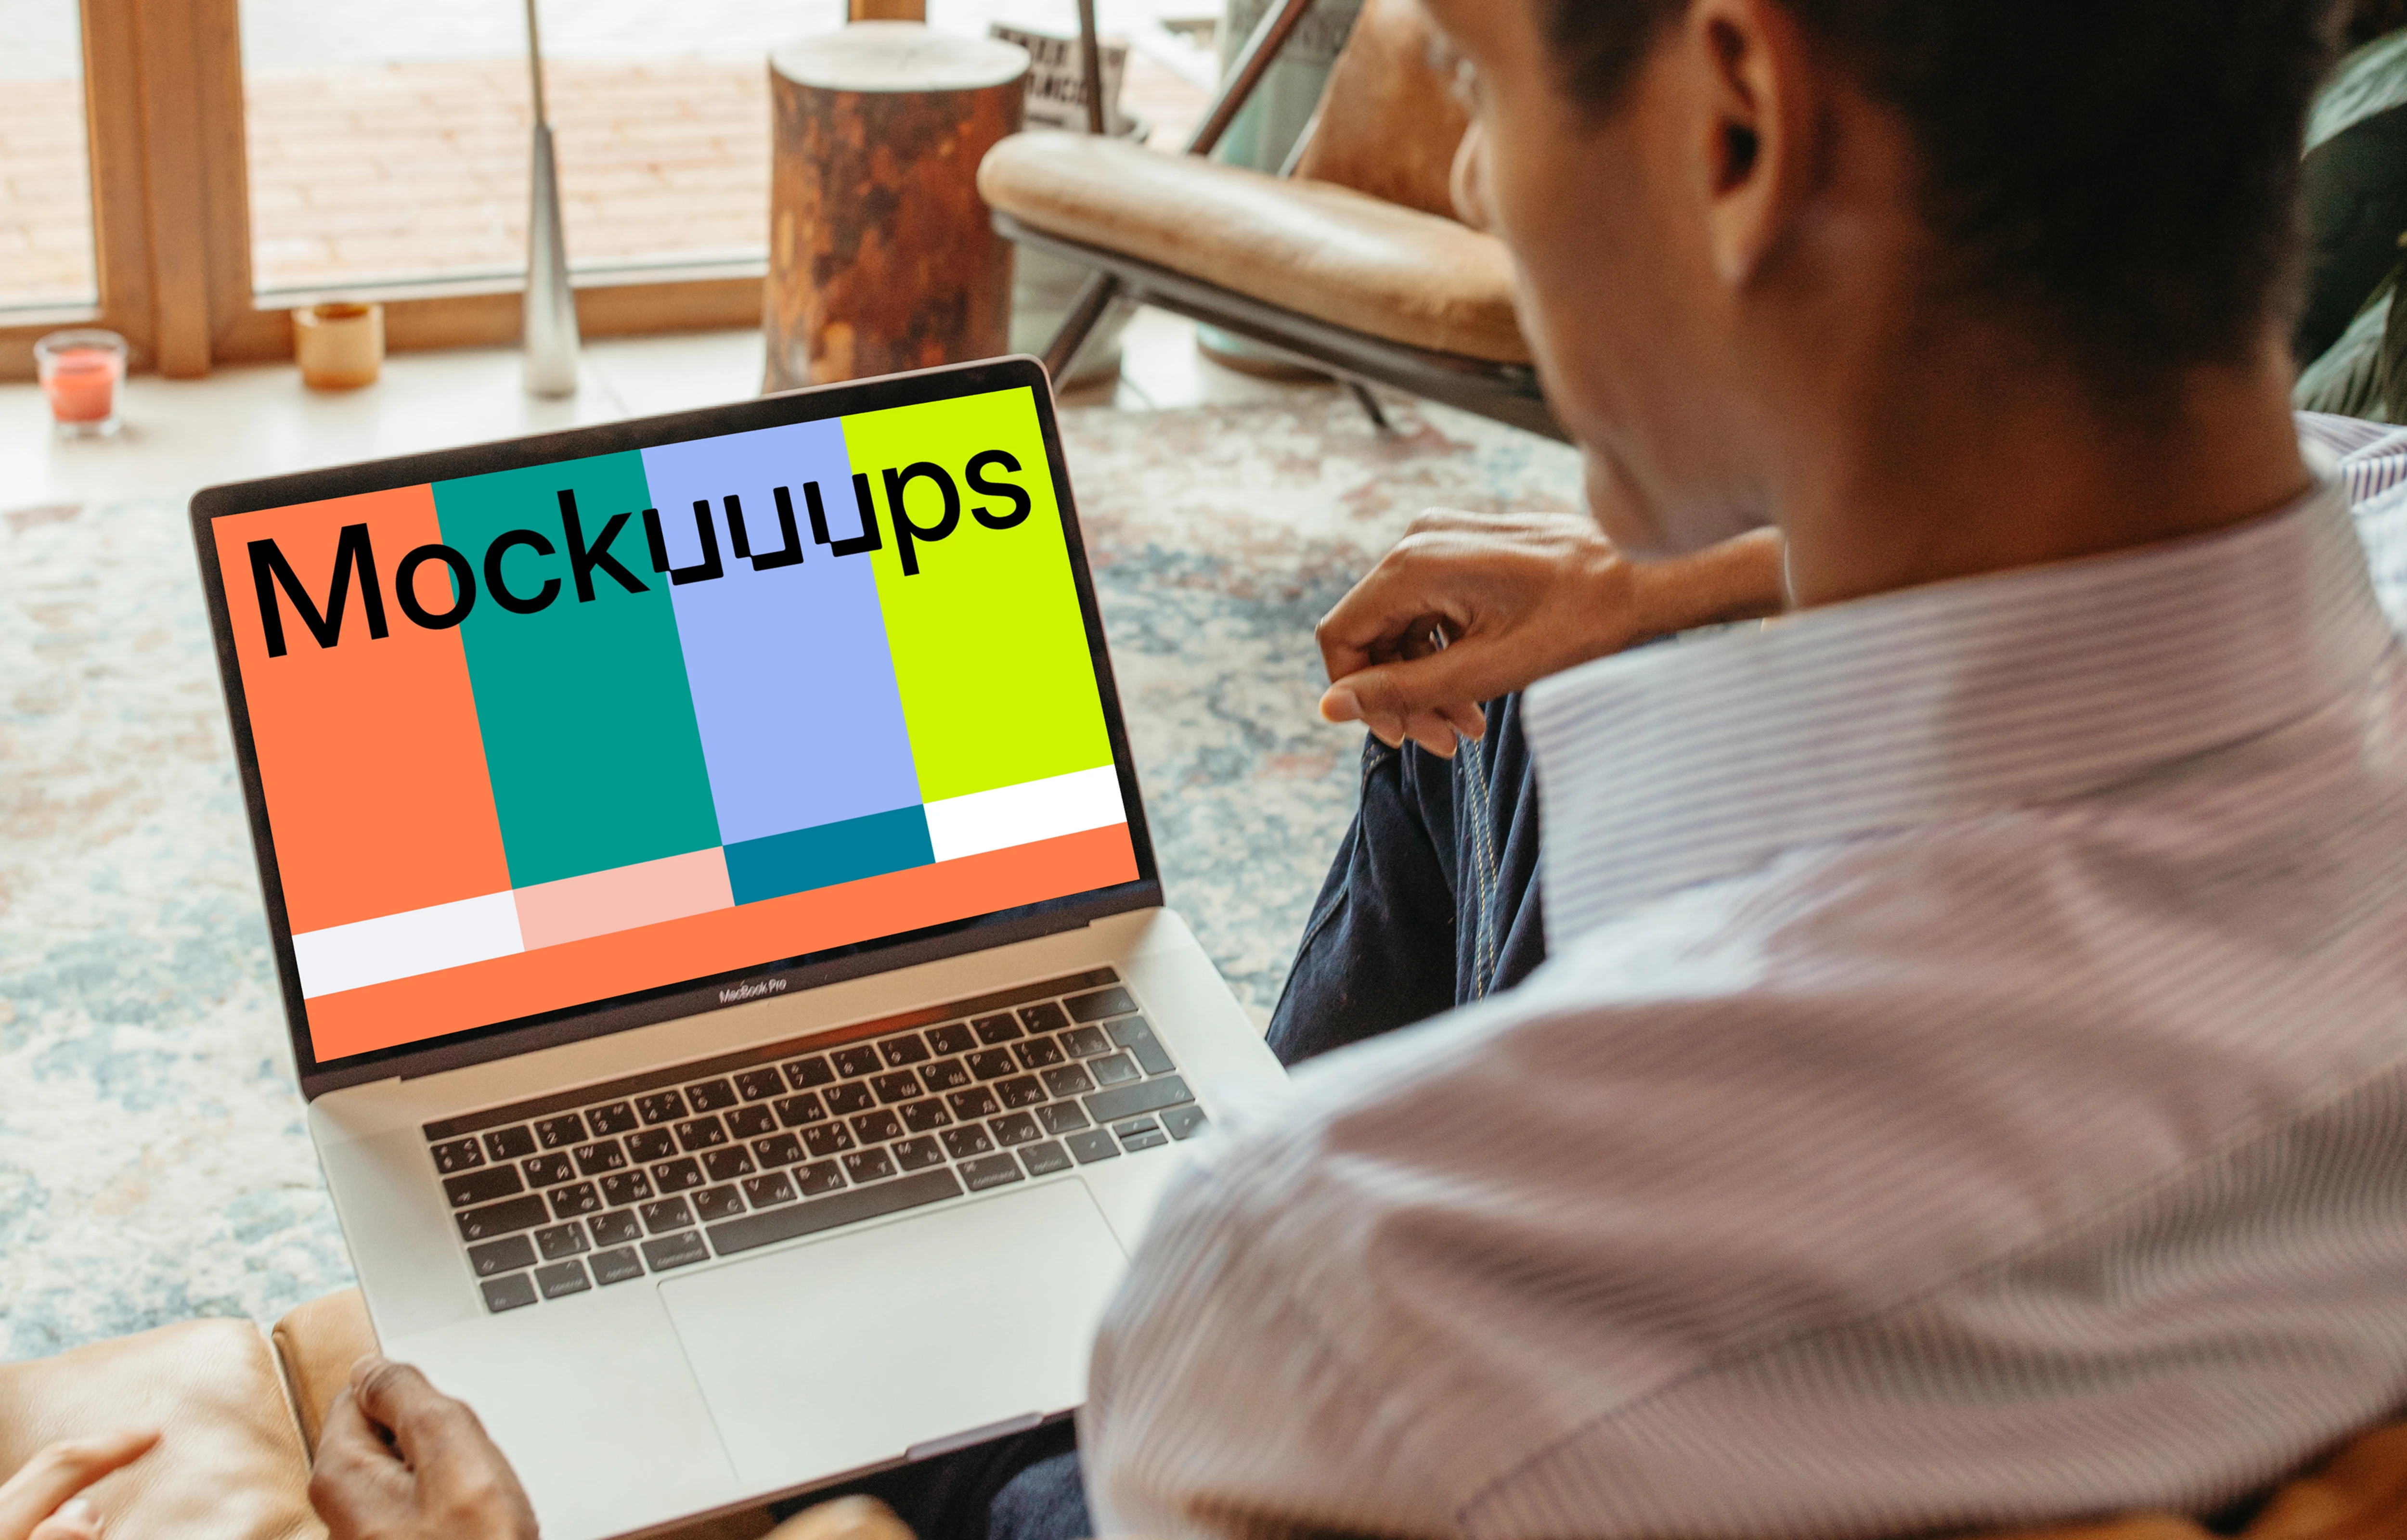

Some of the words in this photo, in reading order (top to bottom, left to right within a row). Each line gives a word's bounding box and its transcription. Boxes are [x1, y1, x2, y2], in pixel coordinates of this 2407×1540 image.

[246, 449, 1032, 658] Mockuuups
[719, 981, 768, 1004] MacBook
[768, 978, 787, 993] Pro
